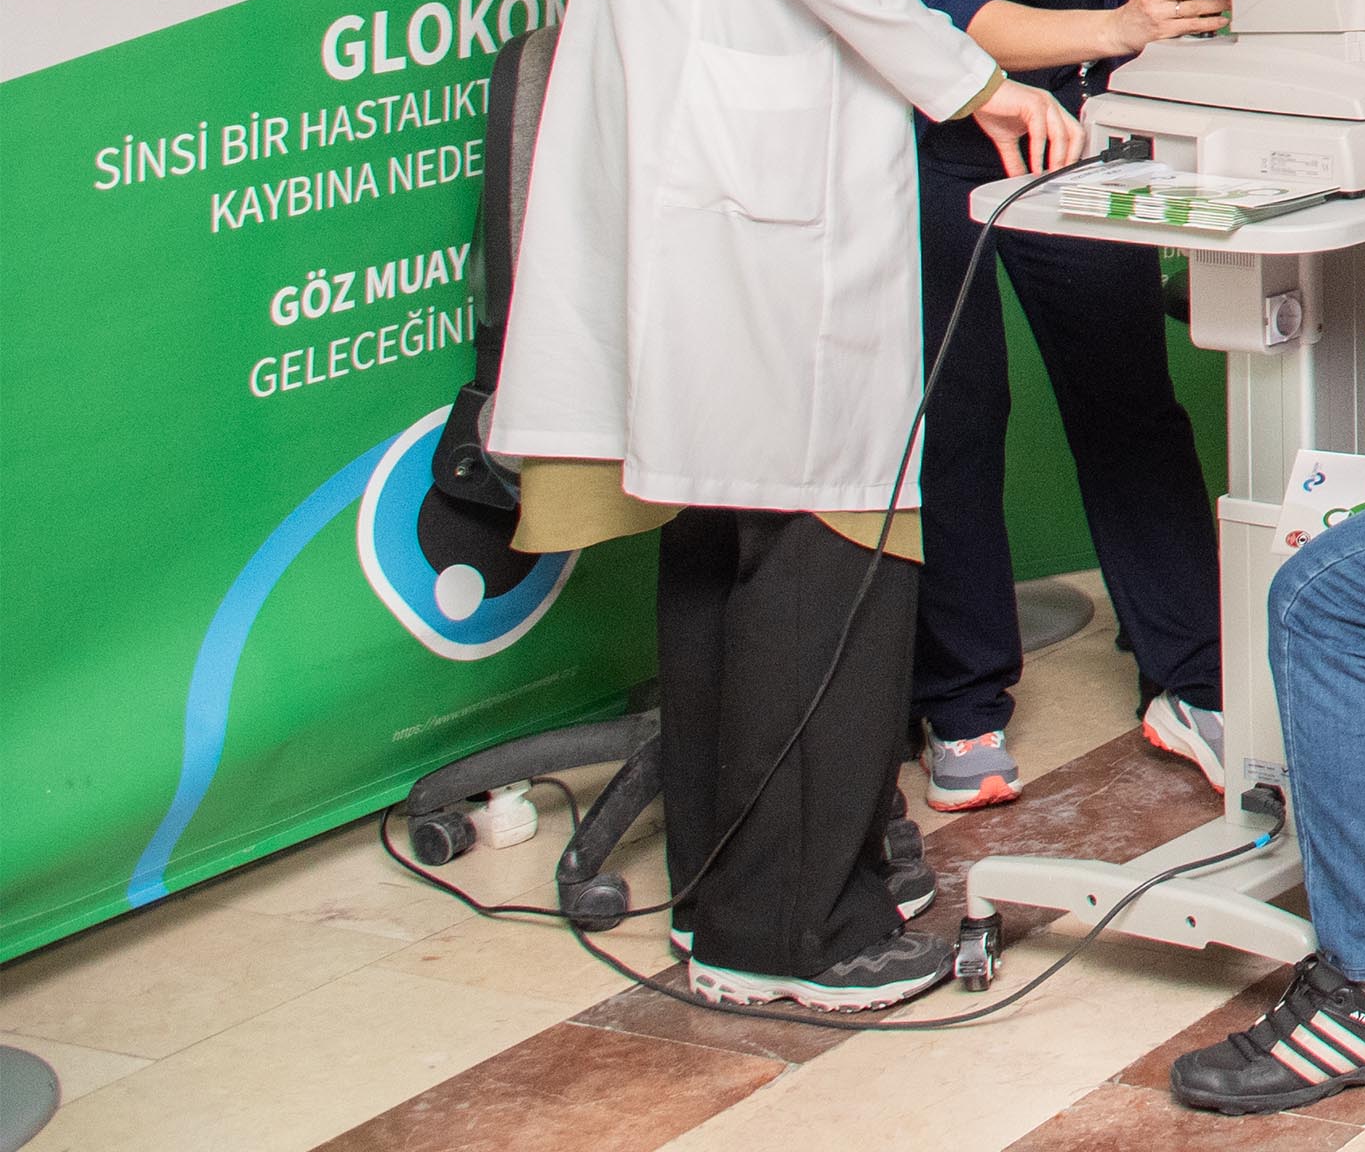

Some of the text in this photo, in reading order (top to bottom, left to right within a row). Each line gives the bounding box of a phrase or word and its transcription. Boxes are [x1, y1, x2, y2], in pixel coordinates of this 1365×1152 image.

[94, 120, 208, 191] SİNSİ
[221, 112, 289, 165] BİR
[211, 168, 380, 234] KAYBINA
[270, 242, 470, 327] GÖZ MUAY
